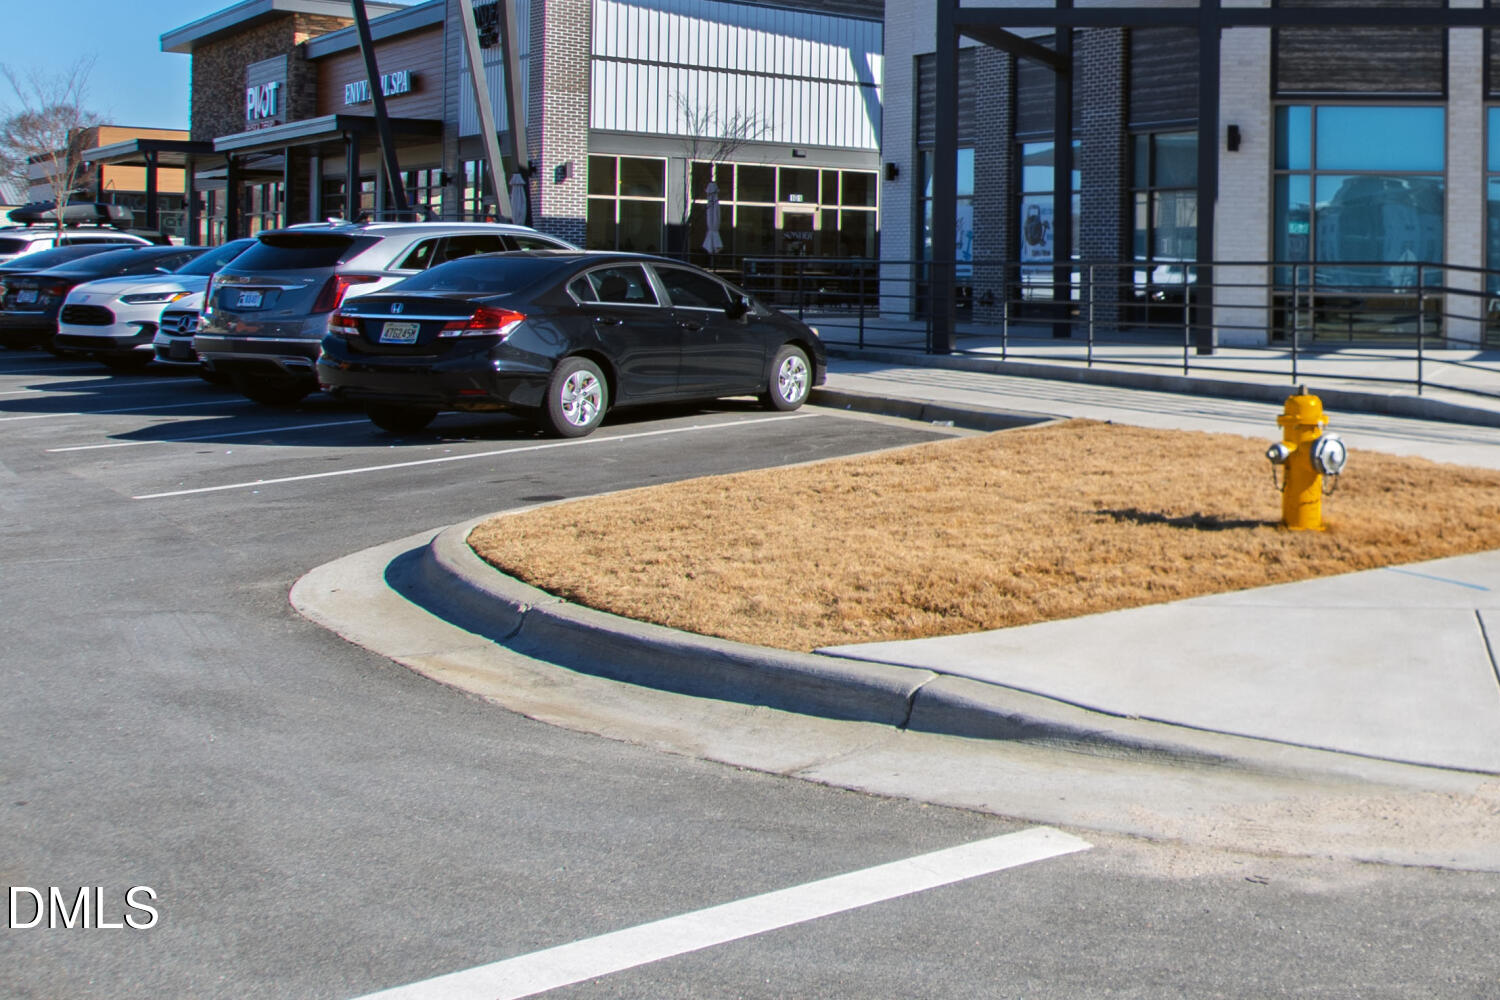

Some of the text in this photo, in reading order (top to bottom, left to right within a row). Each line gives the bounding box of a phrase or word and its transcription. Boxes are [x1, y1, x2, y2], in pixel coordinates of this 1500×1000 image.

[247, 82, 281, 120] PIVOT
[345, 80, 368, 104] ENVY
[391, 70, 411, 95] SPA
